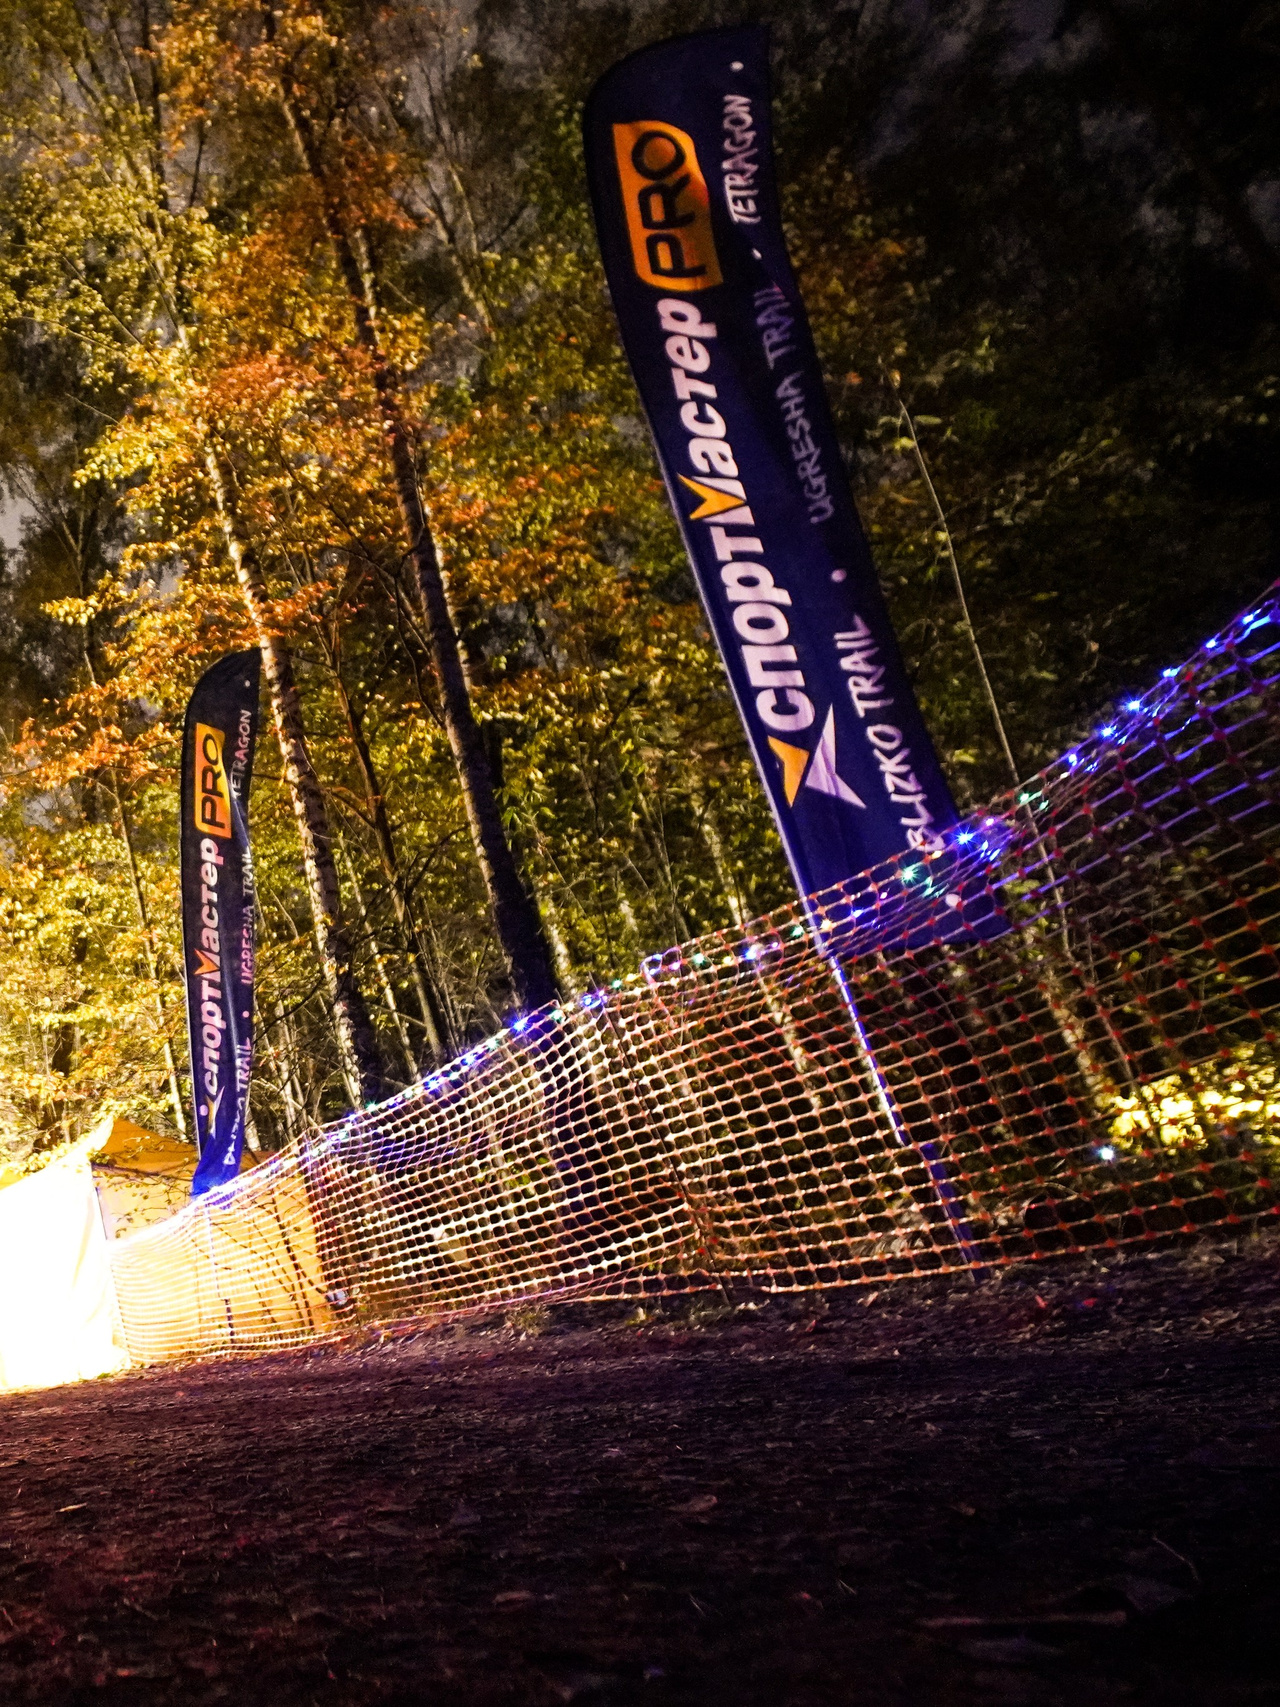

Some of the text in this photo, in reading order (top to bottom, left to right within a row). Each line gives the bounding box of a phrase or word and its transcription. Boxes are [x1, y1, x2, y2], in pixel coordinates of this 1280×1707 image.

[631, 130, 706, 279] PRO
[722, 93, 761, 225] TETRAGON
[775, 370, 835, 525] UGRESHA
[833, 614, 894, 718] TRAIL
[202, 732, 226, 830] PRO
[230, 709, 253, 800] TETRAGON
[866, 723, 946, 854] BLIZKO
[241, 846, 256, 897] TRAIL
[236, 1036, 252, 1093] TRAIL
